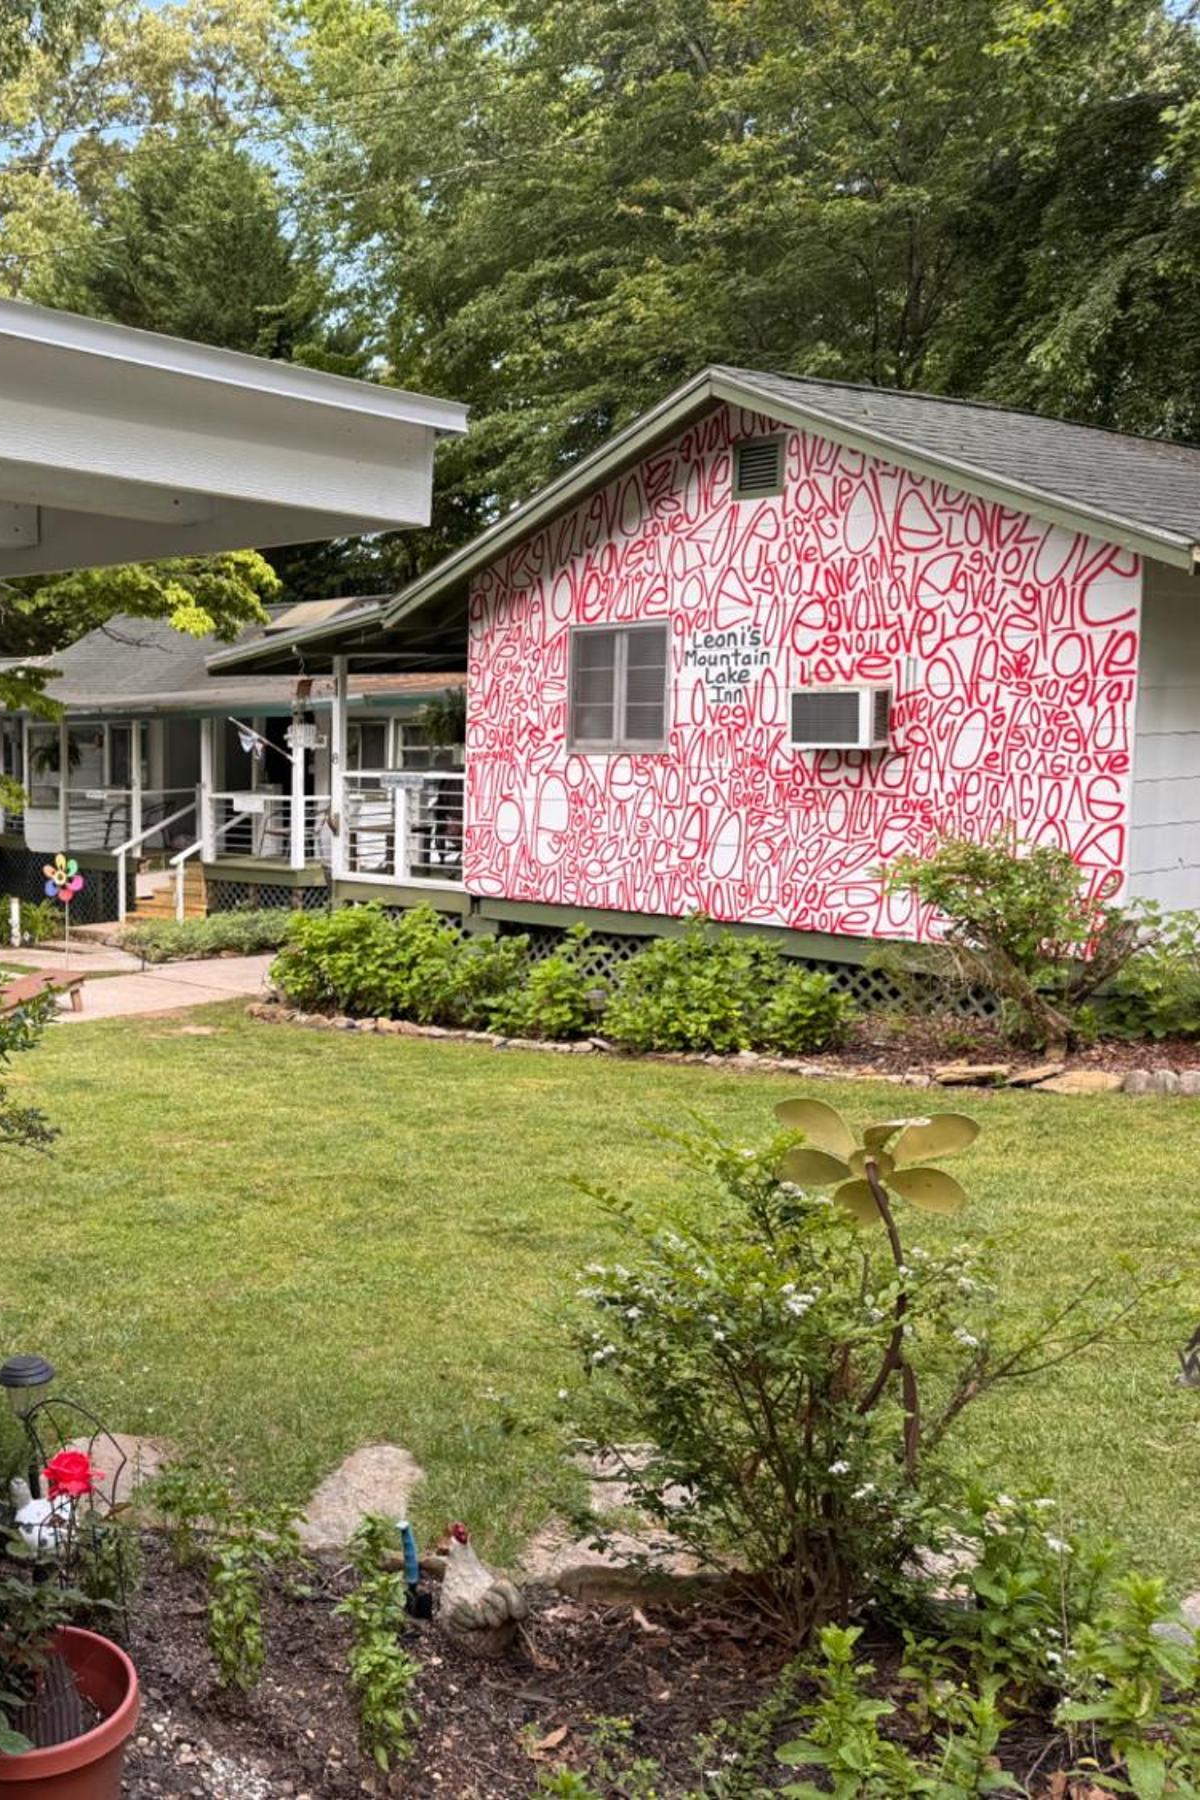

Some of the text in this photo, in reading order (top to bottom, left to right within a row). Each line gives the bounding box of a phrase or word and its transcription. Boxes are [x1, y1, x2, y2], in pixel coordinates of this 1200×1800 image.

[693, 625, 761, 649] Leoni's
[684, 648, 770, 667] Mountain
[705, 667, 751, 684] Lake
[710, 685, 743, 704] Inn
